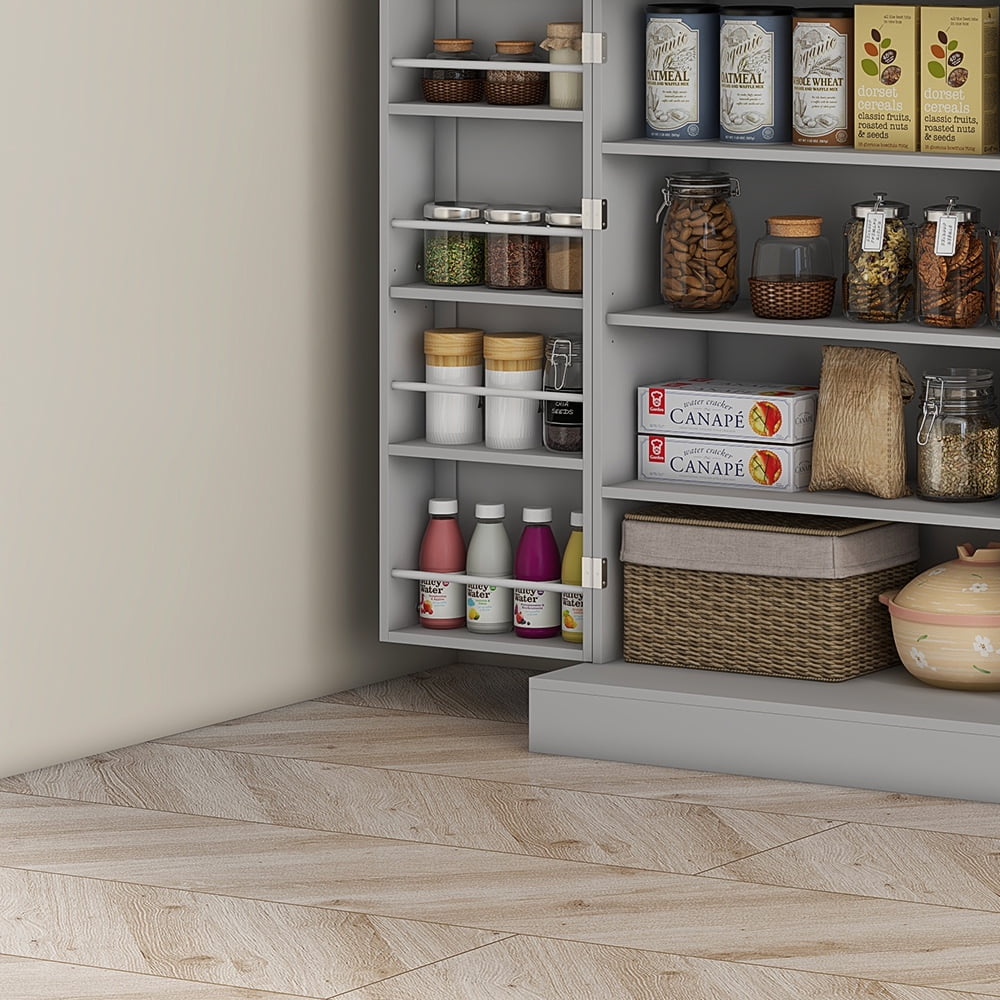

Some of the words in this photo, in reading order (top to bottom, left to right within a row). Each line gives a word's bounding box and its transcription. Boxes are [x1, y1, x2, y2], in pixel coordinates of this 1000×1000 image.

[812, 78, 843, 86] WHEAT
[858, 86, 898, 97] dorset
[924, 88, 965, 100] dorset
[858, 99, 903, 111] cereals
[924, 102, 970, 114] cereals
[858, 112, 885, 120] classic
[887, 113, 911, 122] fruits,
[924, 114, 951, 123] classic
[953, 115, 978, 125] fruits,
[858, 122, 888, 130] roasted
[924, 125, 954, 133] roasted
[867, 131, 888, 139] seeds
[924, 133, 932, 141] &
[933, 134, 955, 142] seeds
[683, 400, 704, 408] water
[706, 400, 733, 410] cracker
[670, 408, 745, 428] CANAPÉ
[683, 448, 704, 457] water
[706, 448, 733, 459] cracker
[670, 456, 745, 477] CANAPÉ
[421, 585, 443, 594] Water
[468, 589, 490, 598] Water
[515, 594, 538, 603] Water
